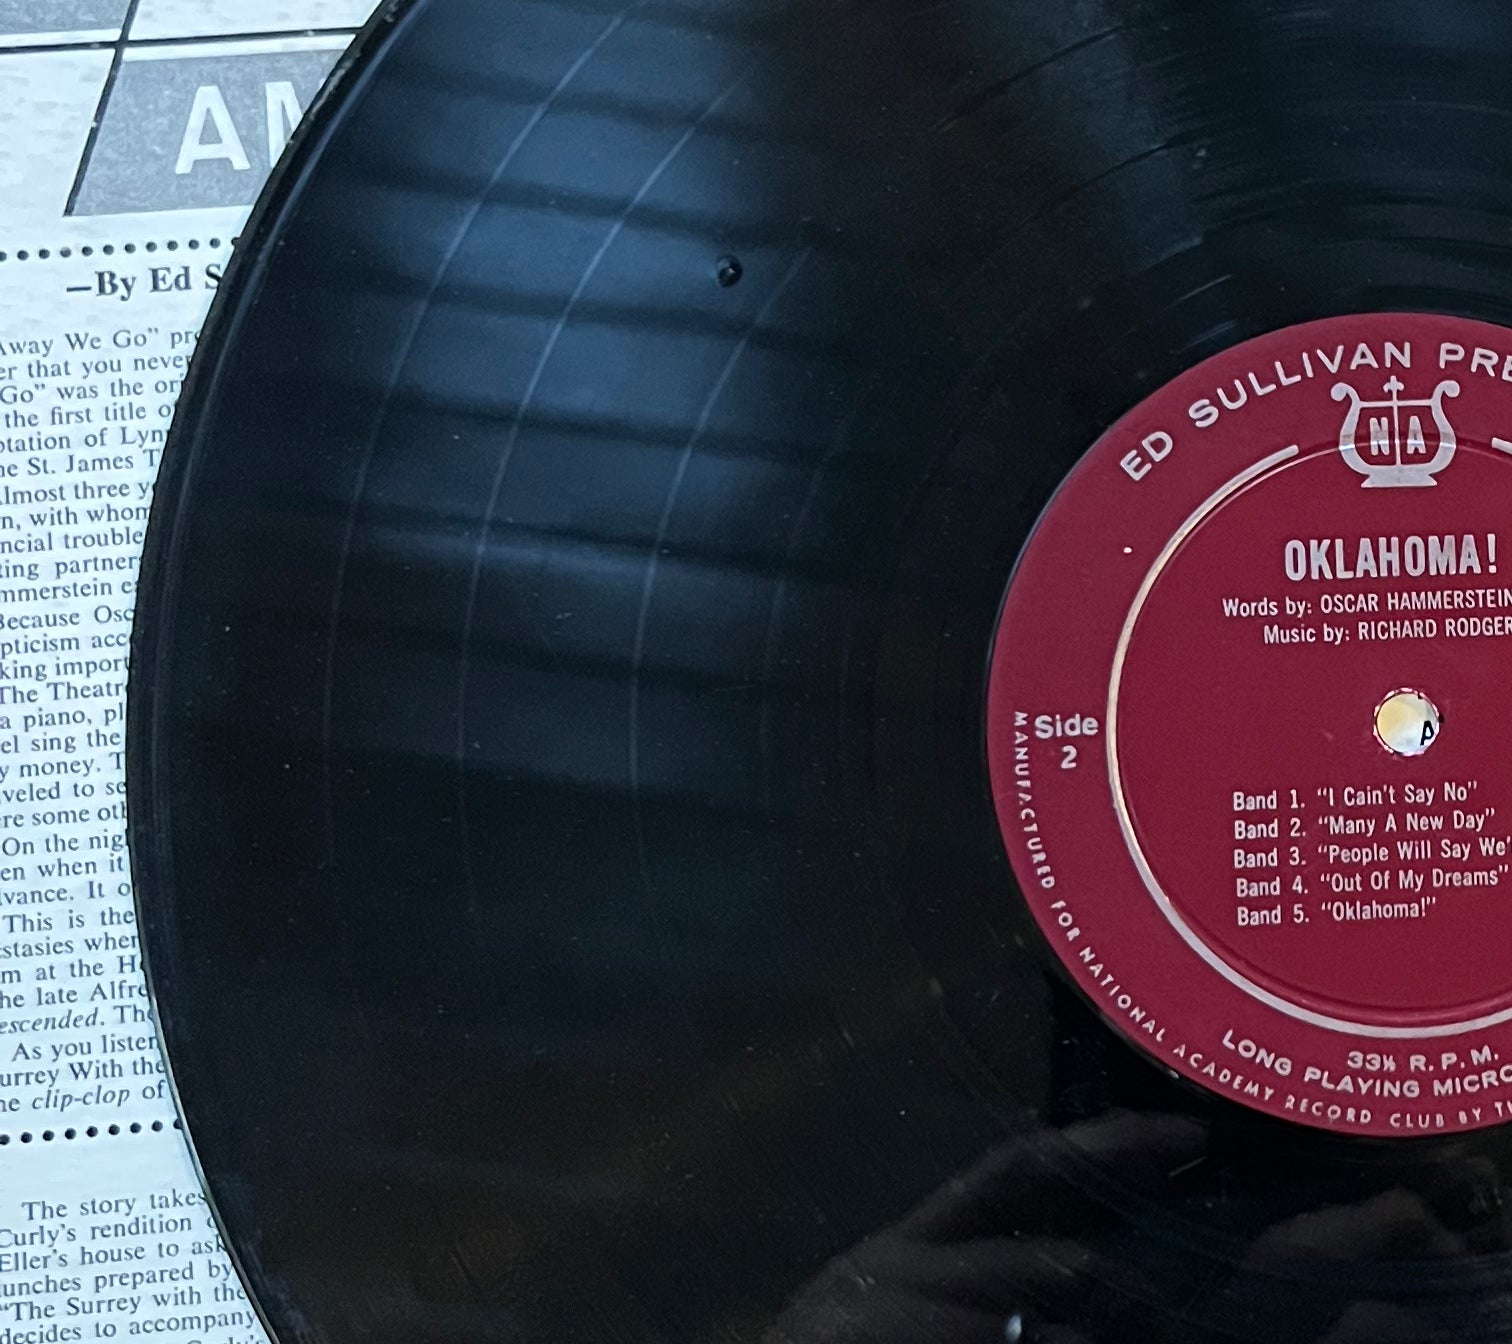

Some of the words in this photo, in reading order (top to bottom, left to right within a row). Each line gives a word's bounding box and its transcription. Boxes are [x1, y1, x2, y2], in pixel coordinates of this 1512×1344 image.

[149, 266, 192, 293] Ed
[64, 332, 101, 350] We
[28, 359, 71, 378] that
[82, 358, 122, 379] you
[57, 385, 99, 400] was
[110, 378, 144, 397] the
[5, 410, 39, 428] the
[50, 407, 91, 425] first
[104, 402, 147, 421] title
[1119, 431, 1173, 481] ED
[1188, 342, 1411, 427] SULLIVAN
[1284, 533, 1498, 582] OKLAHOMA!
[1222, 597, 1278, 617] Words
[1285, 596, 1312, 619] by:
[1320, 593, 1379, 614] OSCAR
[1263, 623, 1316, 645] Music
[1323, 623, 1350, 645] by:
[1358, 618, 1437, 641] RICHARD
[1034, 713, 1099, 740] Side
[1060, 745, 1078, 770] 2
[1233, 789, 1277, 811] Band
[1290, 789, 1306, 809] 1.
[1343, 784, 1396, 806] Cain't
[1404, 783, 1435, 806] Say
[1234, 818, 1279, 840] Band
[1289, 817, 1306, 837] 2.
[1385, 813, 1397, 833] A
[1406, 812, 1444, 832] New
[1233, 847, 1278, 869] Band
[1289, 845, 1306, 866] 3.
[1397, 839, 1432, 861] Will
[1440, 838, 1471, 862] Say
[1236, 876, 1281, 898] Band
[1291, 875, 1309, 895] 4.
[1370, 869, 1391, 891] Of
[1398, 869, 1424, 893] My
[3, 911, 53, 933] This
[68, 910, 85, 929] is
[100, 907, 135, 926] the
[1014, 711, 1056, 889] MANUFACTURED
[1051, 900, 1081, 942] FOR
[1079, 946, 1165, 1043] NATIONAL
[1173, 1044, 1274, 1102] ACADEMY
[1284, 1094, 1372, 1124] RECORD
[1389, 1112, 1445, 1129] CLUB
[1458, 1107, 1482, 1125] BY
[1237, 904, 1282, 927] Band
[1293, 903, 1310, 924] 5.
[11, 1043, 42, 1062] As
[51, 1040, 92, 1061] you
[1222, 1029, 1293, 1076] LONG
[1303, 1066, 1420, 1098] PLAYING
[32, 1085, 130, 1112] clip-clop
[142, 1080, 165, 1099] of
[21, 1200, 67, 1221] The
[80, 1197, 136, 1216] story
[150, 1189, 206, 1209] takes
